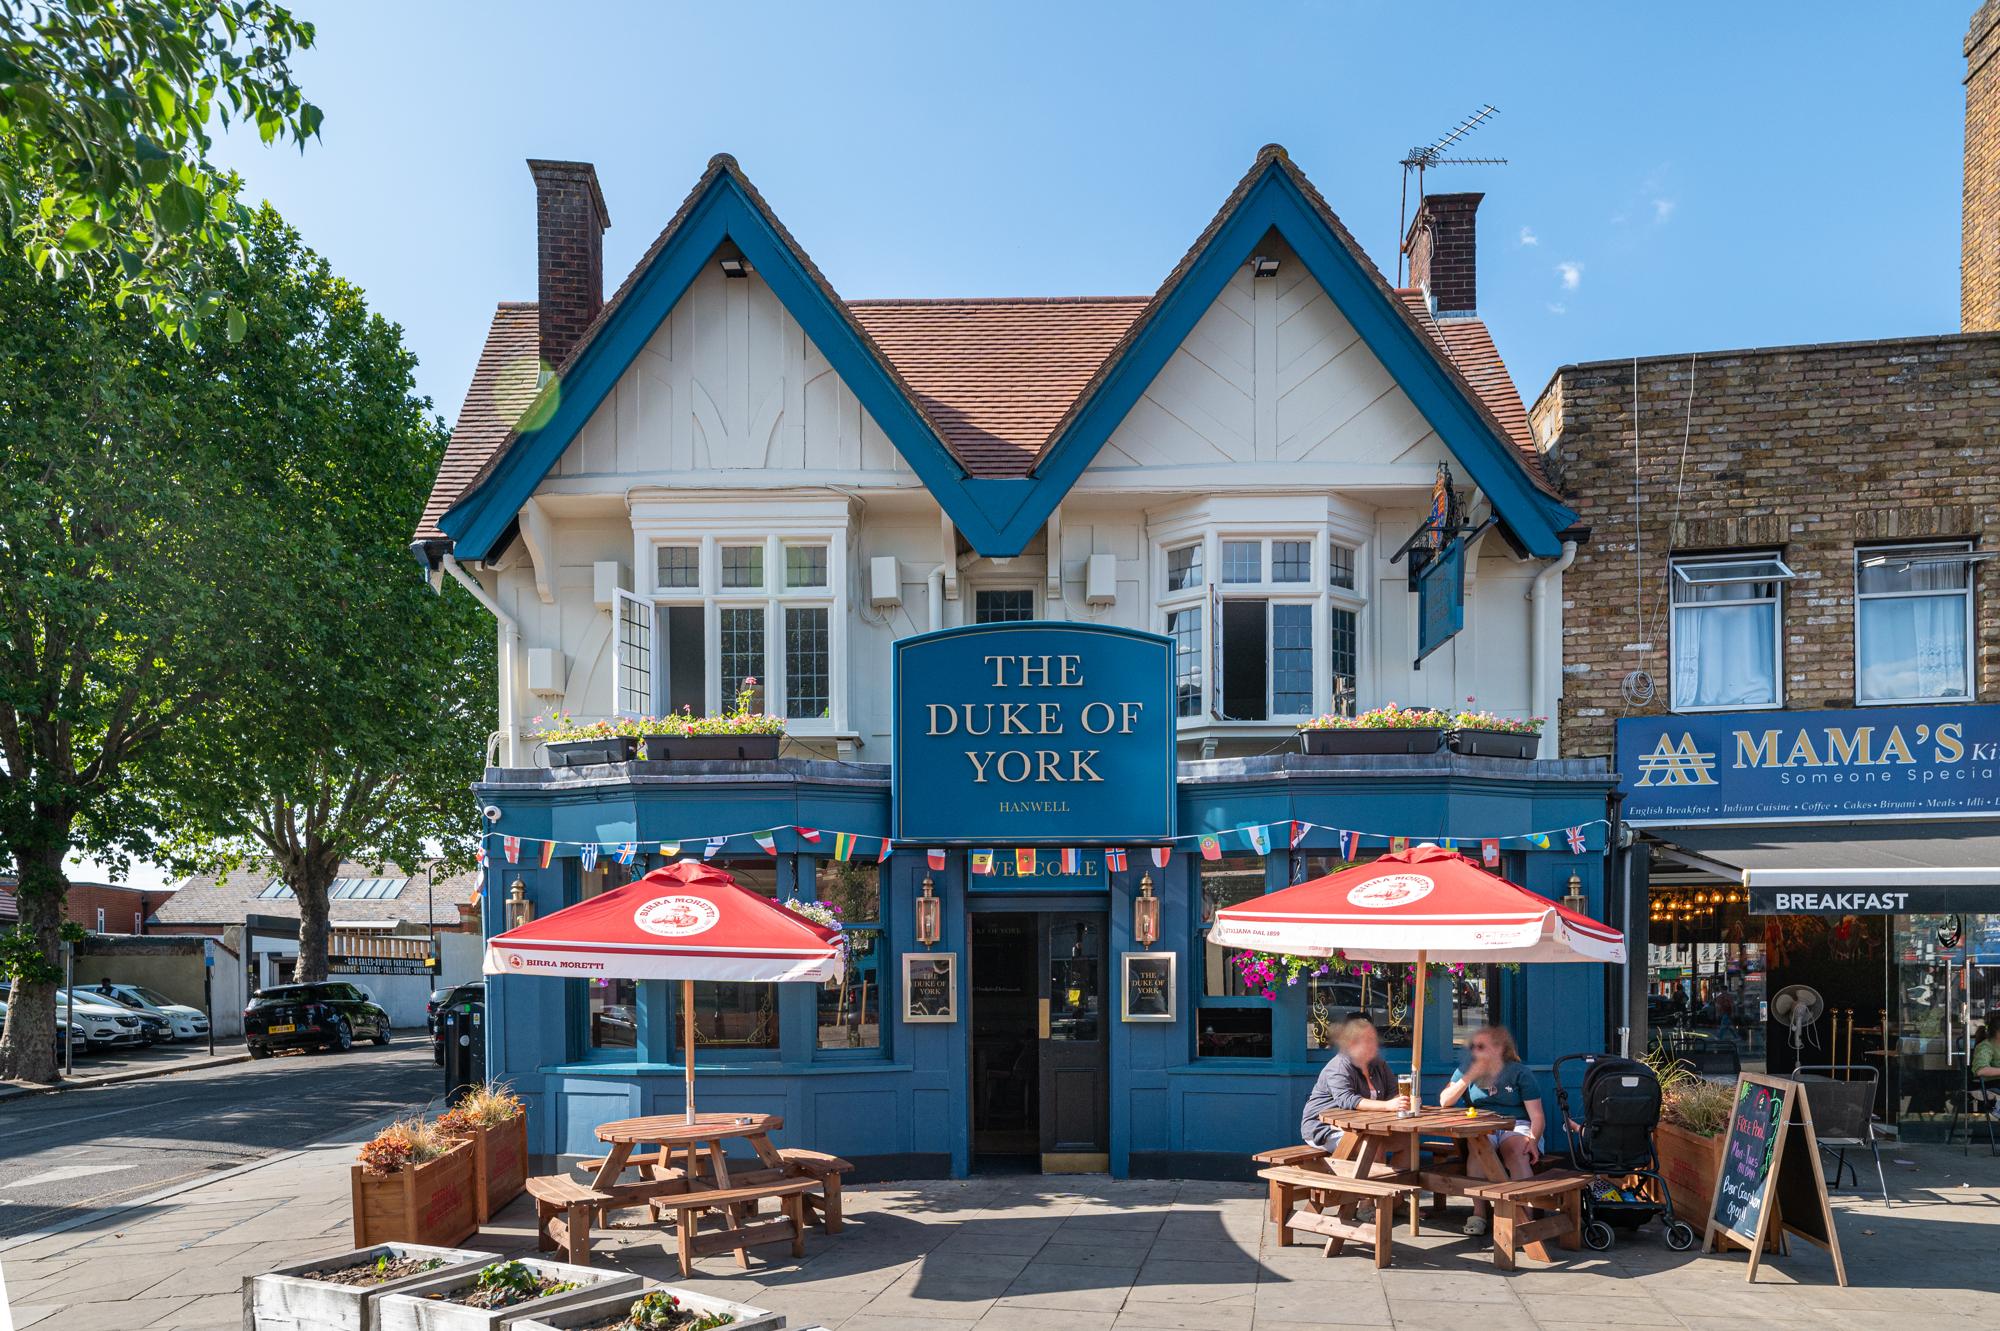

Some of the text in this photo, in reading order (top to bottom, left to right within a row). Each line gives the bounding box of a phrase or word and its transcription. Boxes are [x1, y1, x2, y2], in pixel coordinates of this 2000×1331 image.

[984, 655, 1084, 687] THE
[925, 702, 1144, 736] DUKE OF
[1732, 722, 2000, 768] MAMA'S Ki
[965, 750, 1105, 783] YORK
[1781, 770, 1892, 784] Someone
[999, 801, 1070, 813] HANWELL
[1629, 806, 1663, 817] English
[1666, 805, 1711, 816] Breakfast
[1723, 803, 1754, 814] Indian
[1756, 802, 1791, 812] Cuisine
[1801, 801, 1831, 813] Coffee
[1843, 800, 1872, 810] Cakes
[1880, 799, 1916, 811] Biryani
[1926, 798, 1956, 808] Meals
[1966, 797, 1985, 807] Idli
[639, 897, 716, 918] BIRRA MORETTI
[1776, 892, 1909, 910] BREAKFAST
[526, 959, 604, 970] BIRRA MORETTI
[1132, 979, 1165, 987] DUKE OF
[1736, 1114, 1751, 1136] FREE
[1723, 1175, 1738, 1195] Beer
[1737, 1182, 1761, 1210] Garden
